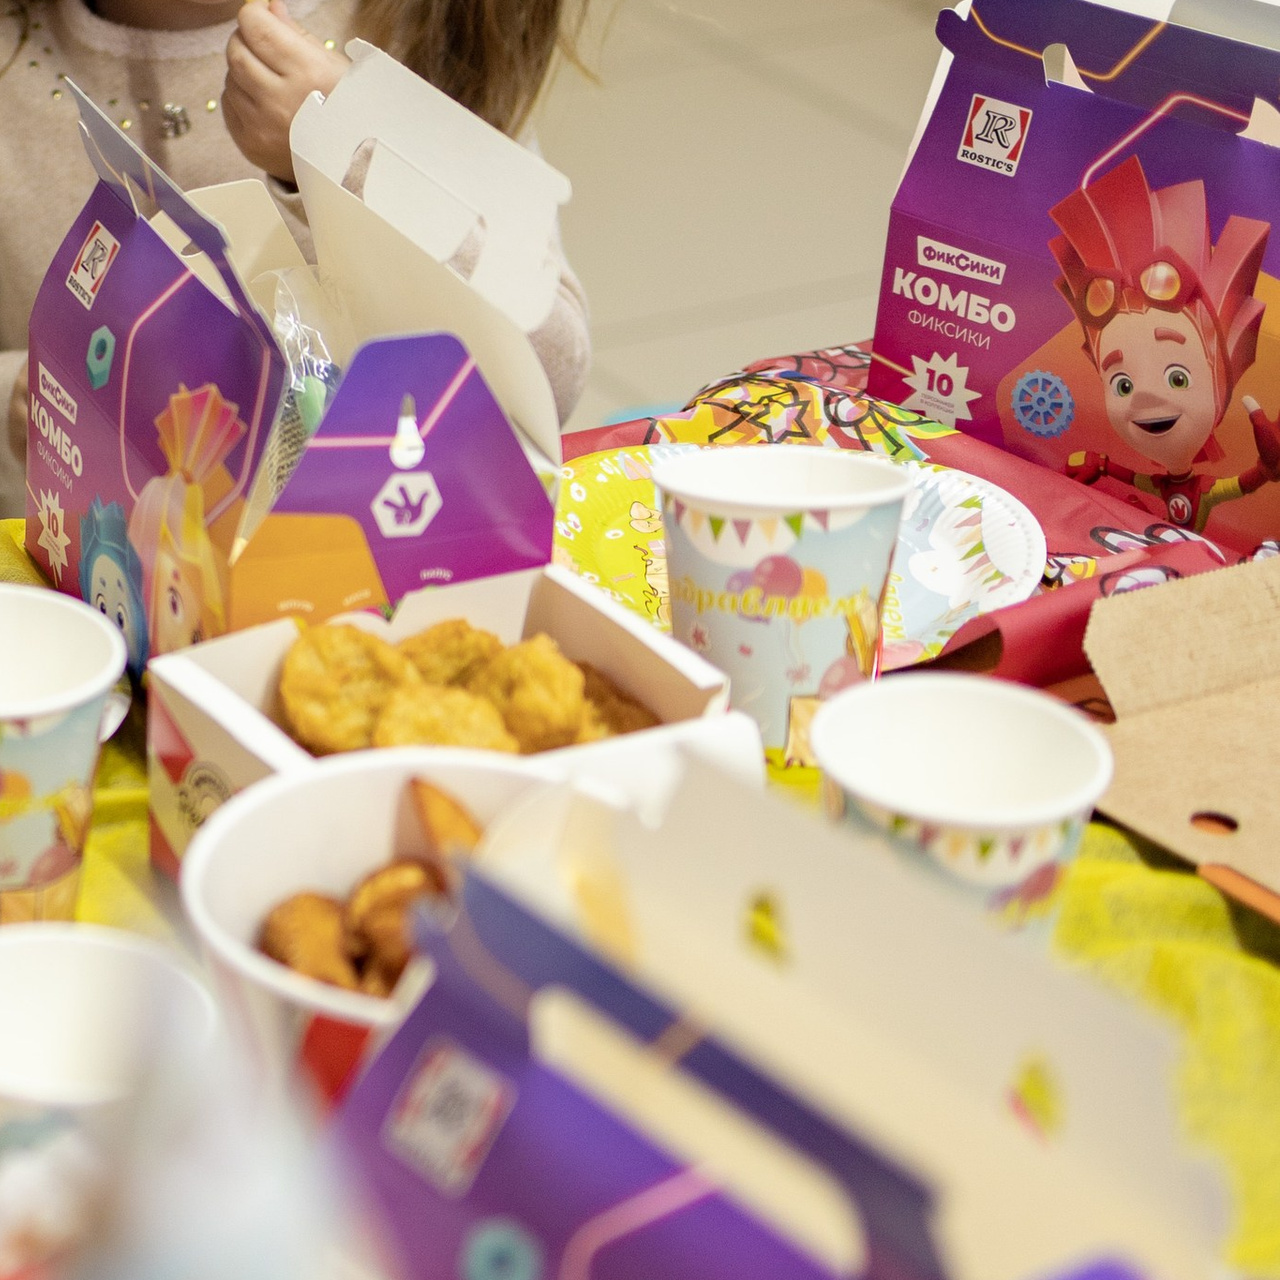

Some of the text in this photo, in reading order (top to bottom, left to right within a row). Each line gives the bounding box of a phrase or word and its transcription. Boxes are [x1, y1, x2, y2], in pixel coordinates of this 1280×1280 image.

[975, 110, 1017, 149] R
[961, 149, 1014, 172] ROSTIC'S
[892, 267, 1016, 333] КОМБО
[908, 310, 991, 350] ФИКСИКИ
[926, 367, 954, 397] 10
[31, 389, 83, 477] КОМБО
[46, 504, 59, 538] 10
